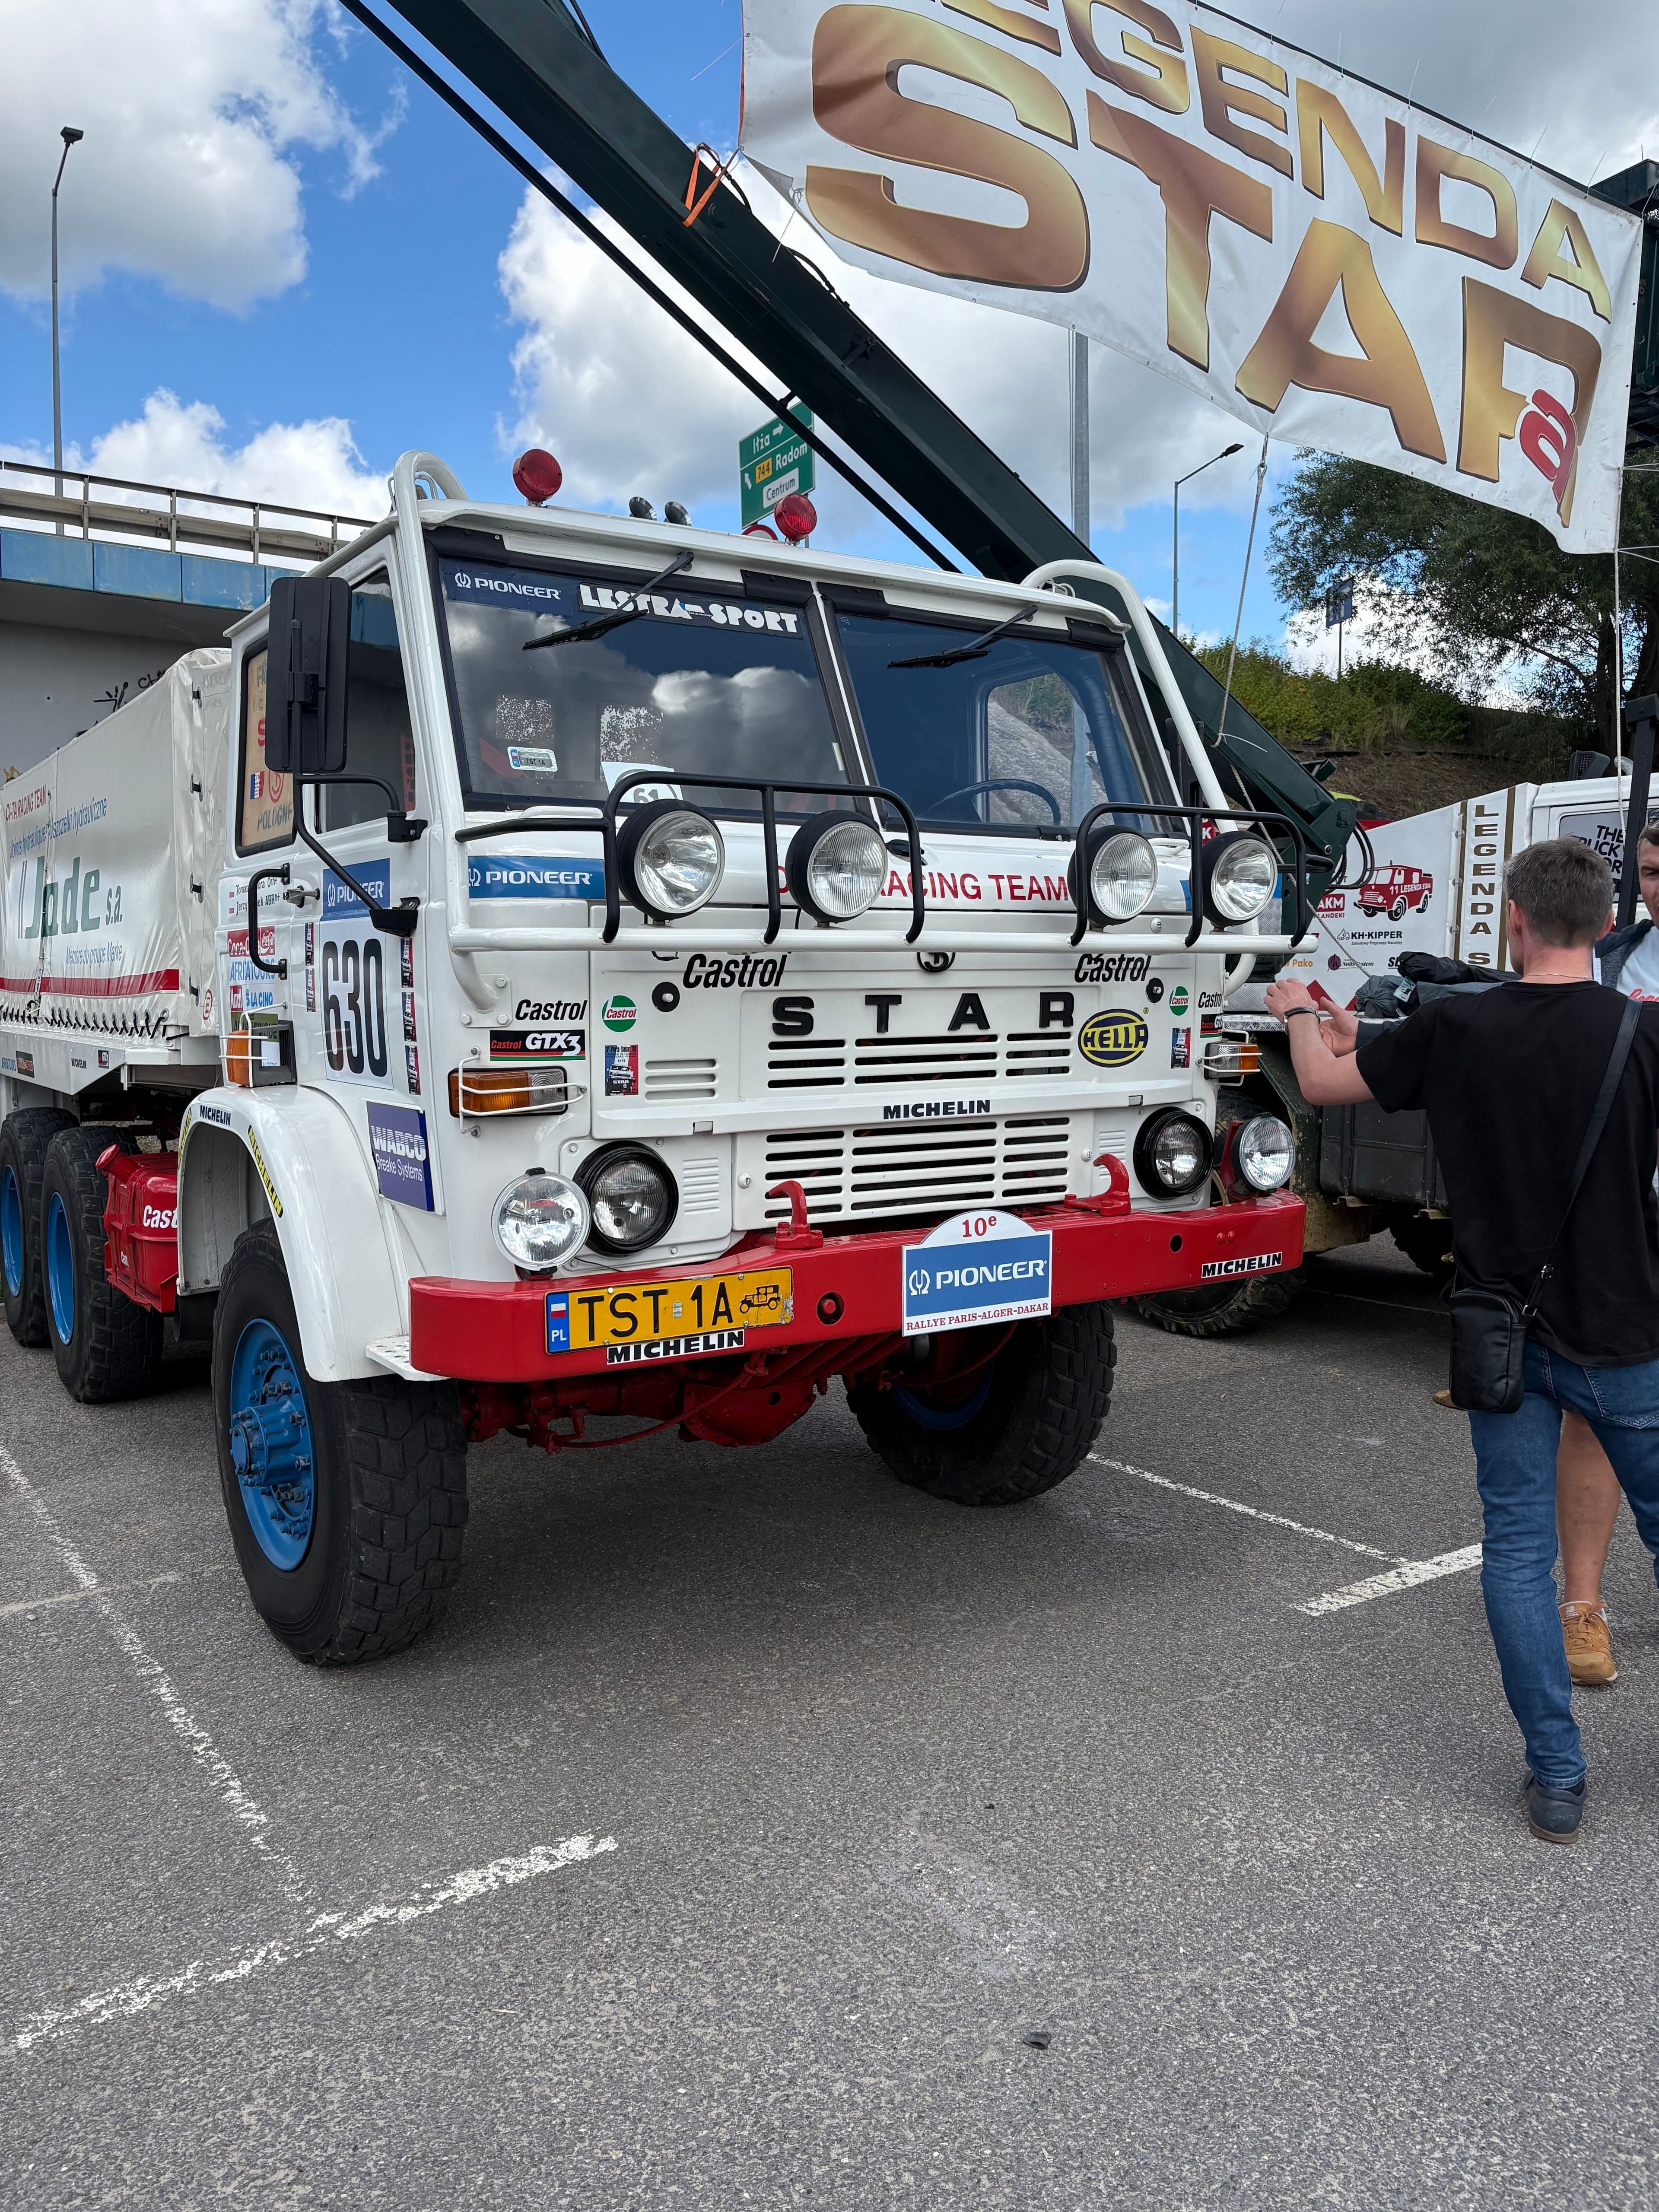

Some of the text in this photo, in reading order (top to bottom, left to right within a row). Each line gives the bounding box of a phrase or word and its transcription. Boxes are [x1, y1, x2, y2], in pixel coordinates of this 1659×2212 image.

[753, 433, 770, 454] Iłża
[757, 442, 807, 480] 744 Radom
[766, 477, 795, 501] Centrum
[474, 577, 561, 600] PIONEER
[18, 792, 34, 818] RACING
[34, 784, 47, 809] TEAM
[1597, 825, 1624, 843] THE
[486, 871, 592, 885] PIONEER
[1469, 804, 1499, 934] LEGENDA
[25, 855, 100, 939] Jade
[987, 874, 1068, 901] TEAM
[1389, 885, 1398, 895] 11
[1400, 884, 1422, 893] LEGENDA
[236, 902, 248, 915] Jerzy
[1351, 931, 1402, 940] KH-KIPPER
[683, 953, 788, 988] Castrol
[1074, 953, 1152, 983] Castrol
[1292, 958, 1313, 967] Pako
[323, 938, 387, 1077] 630
[515, 999, 587, 1020] Castrol
[1172, 996, 1189, 1005] Castrol
[606, 1009, 637, 1018] Castrol
[772, 992, 1074, 1036] STAR
[491, 1033, 581, 1056] Castrol GTX3
[1083, 1023, 1149, 1048] HELLA
[200, 1105, 231, 1126] MICHELIN
[883, 1100, 991, 1120] MICHELIN
[371, 1125, 426, 1161] WABCO
[248, 1127, 283, 1216] MICHELIN
[375, 1153, 423, 1182] Breake Systems
[936, 1259, 1047, 1290] PIONEER
[1202, 1252, 1282, 1278] MICHELIN
[577, 1281, 733, 1341] TST 1A
[551, 1329, 567, 1342] PL
[906, 1317, 946, 1331] RALLYE
[608, 1331, 744, 1363] MICHELIN
